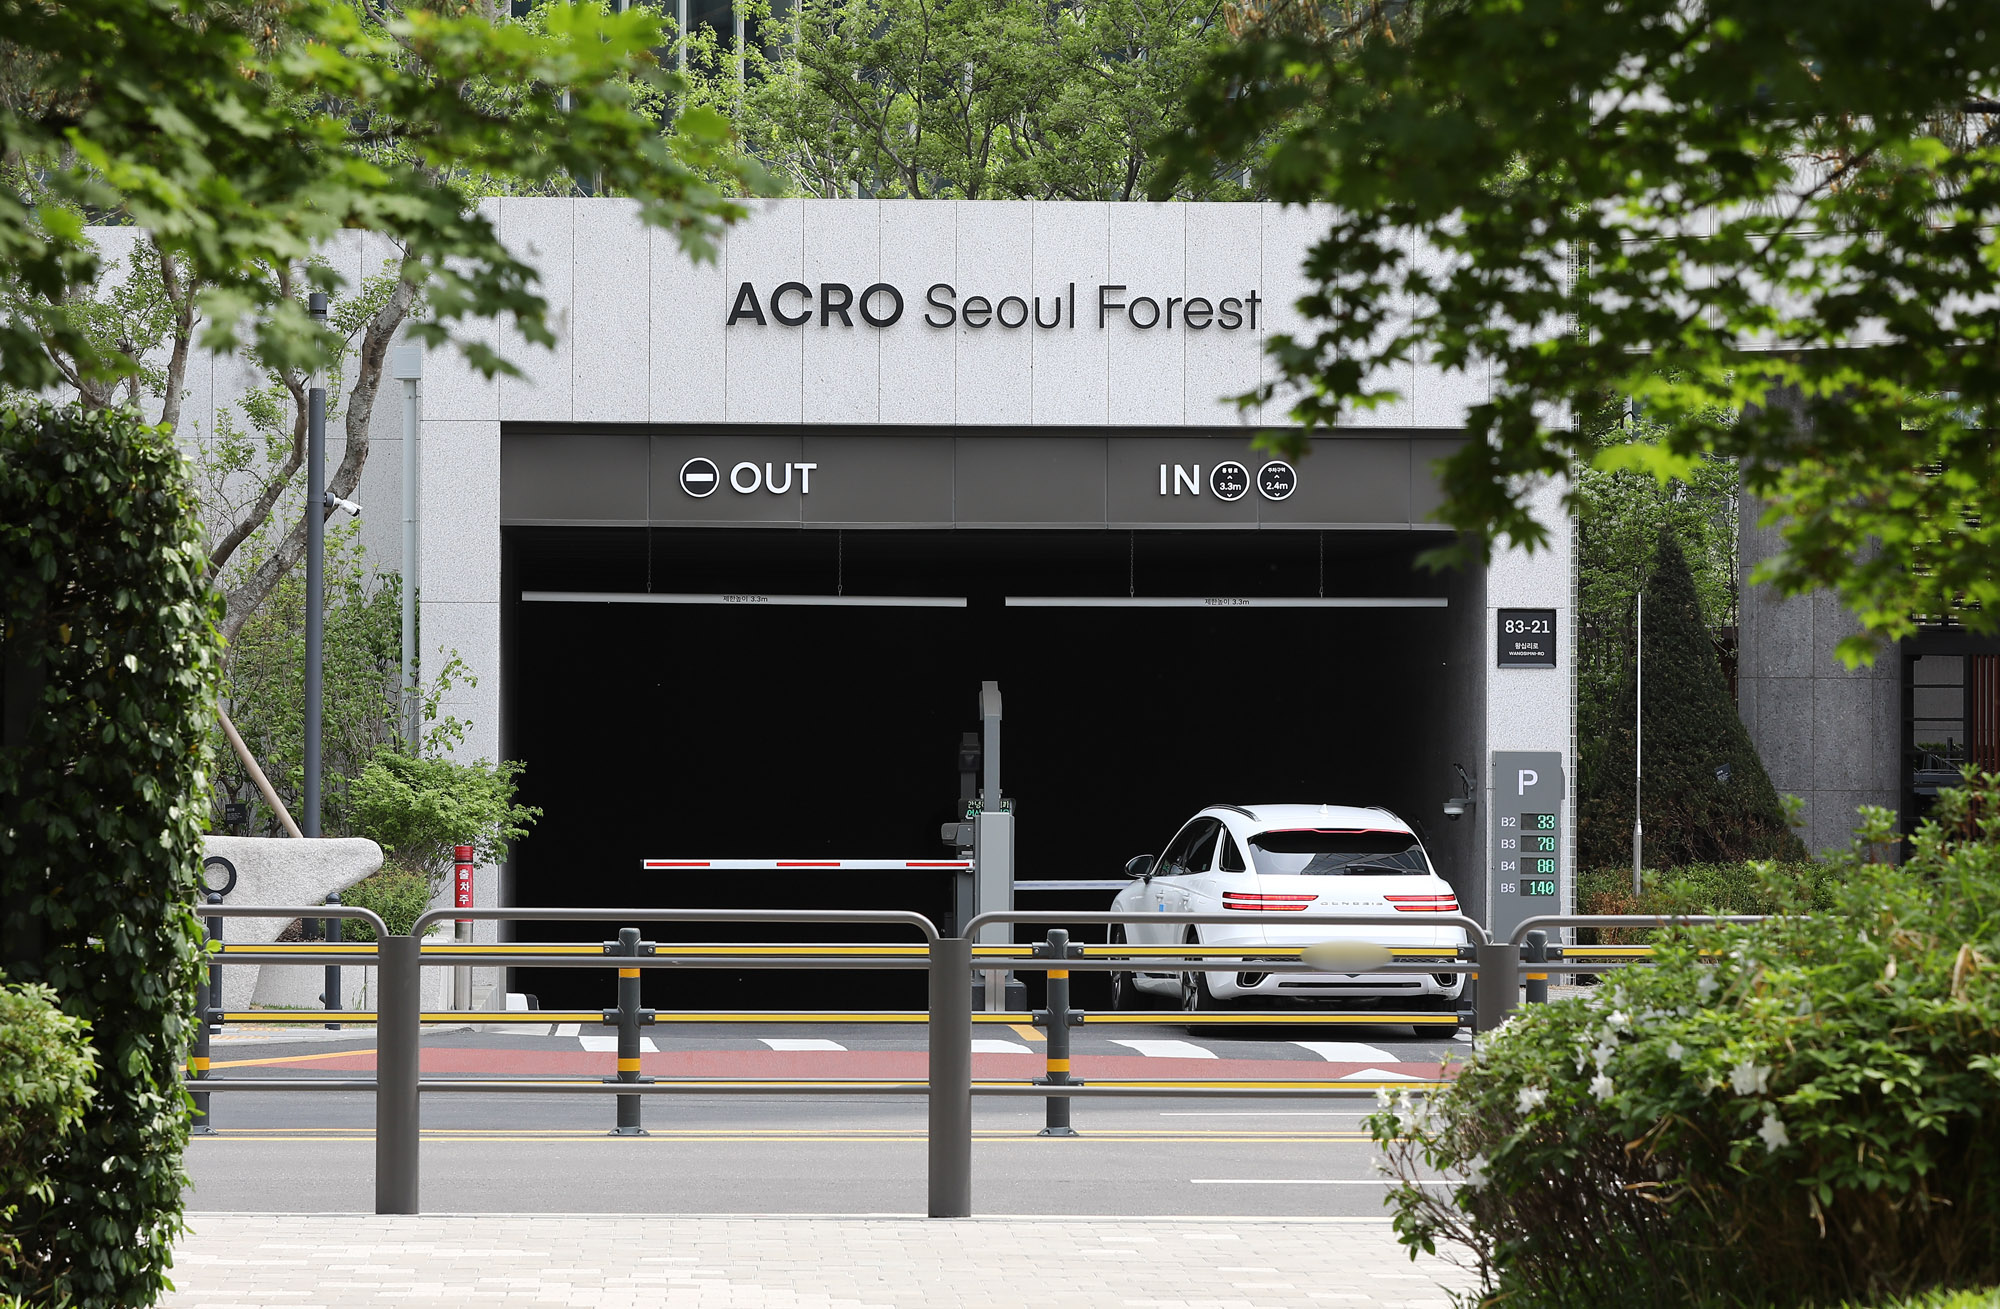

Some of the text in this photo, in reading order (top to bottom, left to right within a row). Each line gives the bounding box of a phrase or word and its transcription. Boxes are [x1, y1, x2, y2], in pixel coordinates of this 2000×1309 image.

[727, 282, 1262, 330] ACRO Seoul Forest
[730, 461, 818, 494] OUT
[1160, 464, 1200, 495] IN
[1219, 482, 1242, 491] 3.3m
[1266, 481, 1288, 490] 2.4m
[1505, 619, 1551, 634] 83-21
[1514, 642, 1539, 650] 왕십리로
[1518, 769, 1539, 796] P
[1501, 815, 1555, 829] B2 33
[1501, 837, 1555, 851] B3 78
[1501, 859, 1555, 873] B4 88
[1501, 881, 1555, 895] B5 140
